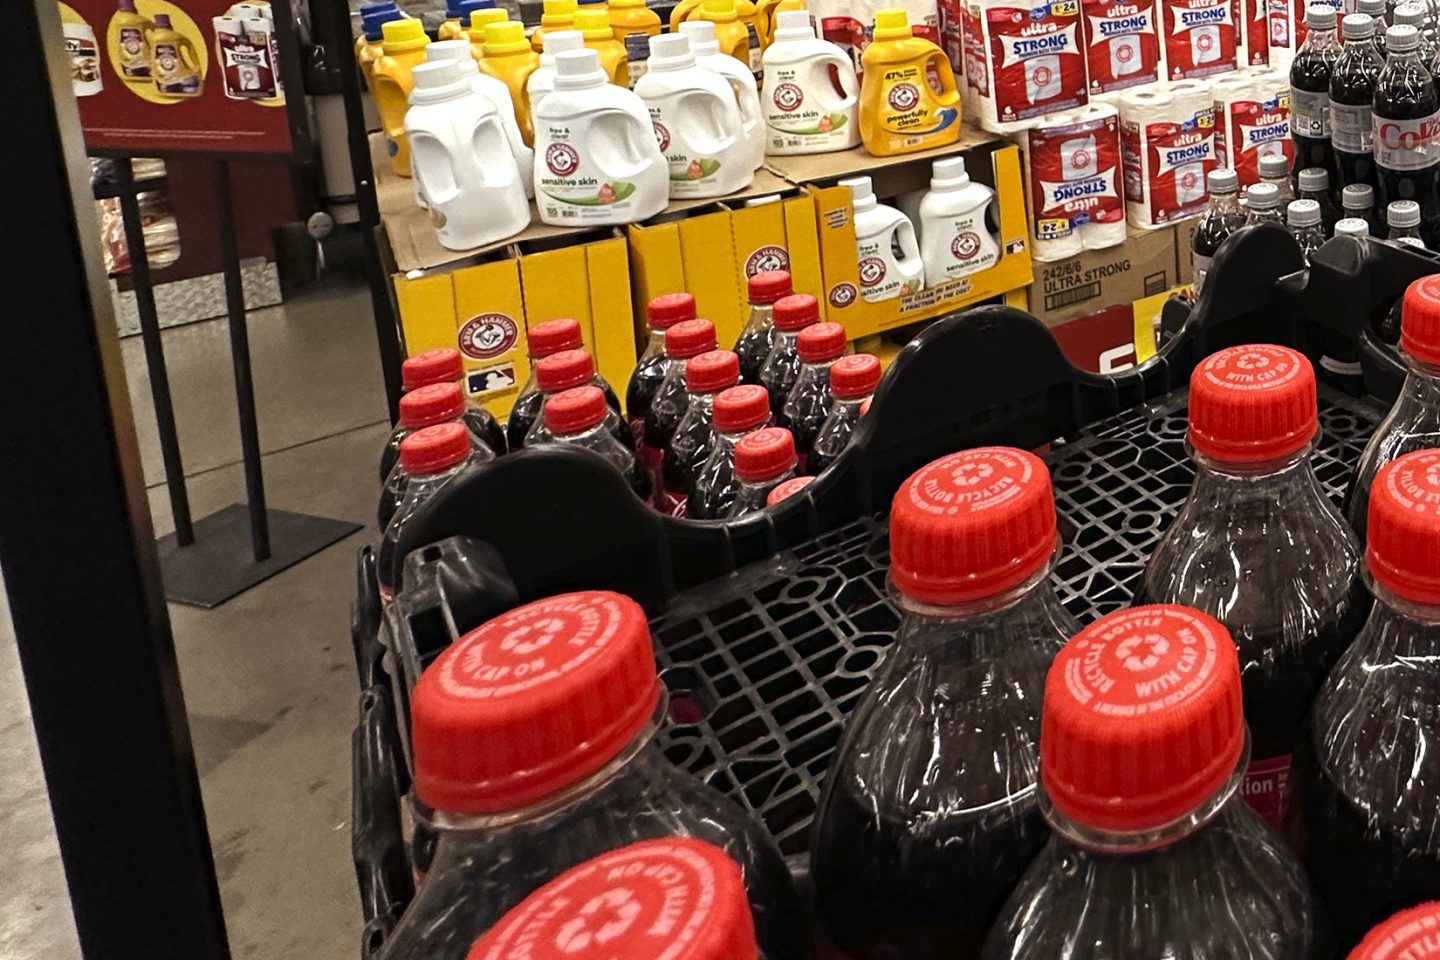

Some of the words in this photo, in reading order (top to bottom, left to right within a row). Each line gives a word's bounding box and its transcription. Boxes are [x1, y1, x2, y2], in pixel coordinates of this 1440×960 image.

[1063, 2, 1076, 11] 24
[1107, 4, 1138, 18] ultra
[1181, 7, 1226, 24] STRONG
[1021, 22, 1057, 37] ultra
[1100, 15, 1147, 34] STRONG
[1013, 33, 1068, 54] STRONG
[231, 52, 261, 64] STRONG
[885, 71, 903, 80] 47%
[769, 112, 801, 121] sensitive
[802, 110, 819, 118] skin
[887, 109, 928, 123] powerfully
[1005, 106, 1012, 114] 6
[897, 117, 920, 126] clean
[1255, 113, 1282, 126] ultra
[1173, 133, 1202, 147] ultra
[1249, 124, 1289, 142] STRONG
[670, 154, 687, 162] skin
[1167, 142, 1210, 162] STRONG
[541, 178, 576, 186] sensitive
[578, 177, 598, 186] skin
[1053, 179, 1107, 199] STRONG
[1064, 197, 1098, 212] ultra
[1042, 222, 1056, 232] 24
[946, 258, 980, 271] sensitive
[980, 253, 995, 264] skin
[1042, 261, 1082, 279] 242/6/6
[1044, 274, 1082, 294] ULTRA
[1084, 259, 1131, 283] STRONG
[885, 281, 900, 291] skin
[463, 327, 473, 345] ARM
[480, 317, 514, 336] HAMMER
[1226, 372, 1254, 382] WITH
[1256, 370, 1277, 381] CAP
[924, 478, 954, 503] BOTTLE
[956, 476, 1014, 504] RECYCLE
[1401, 469, 1425, 499] BOTTLE
[1176, 627, 1198, 644] ON
[1084, 642, 1116, 694] RECYCLE
[1100, 617, 1164, 642] BOTTLE
[1176, 650, 1200, 673] CAP
[473, 663, 511, 681] CAP
[513, 656, 545, 677] ON
[1135, 673, 1181, 699] WITH
